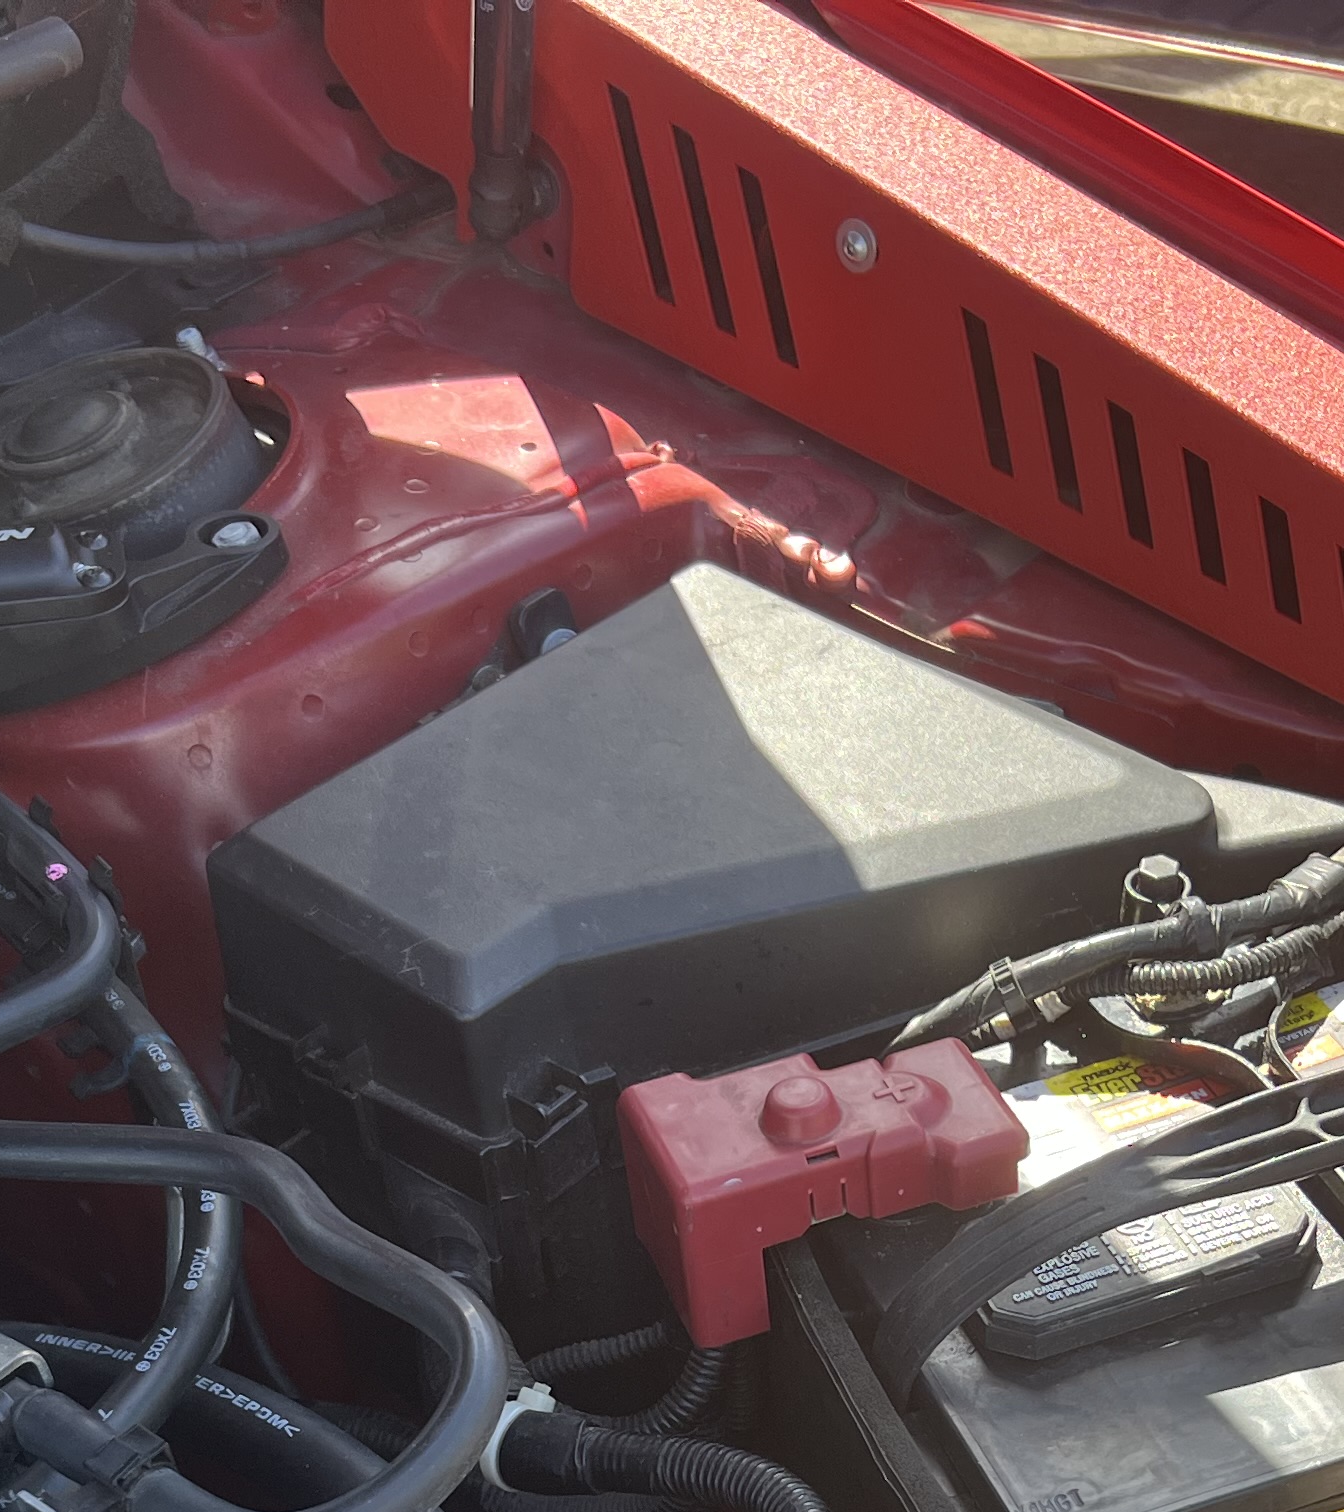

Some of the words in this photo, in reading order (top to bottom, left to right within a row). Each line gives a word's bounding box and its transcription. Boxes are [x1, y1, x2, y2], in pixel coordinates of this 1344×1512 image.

[1081, 1060, 1133, 1082] maxx
[1181, 1202, 1244, 1230] SULFURIC
[1244, 1192, 1276, 1212] ACID
[1130, 1231, 1156, 1246] NO
[187, 1246, 211, 1281] 7X03
[1032, 1245, 1100, 1275] EXPLOSIVE
[1037, 1263, 1081, 1284] GASES
[1012, 1289, 1035, 1304] CAN
[1033, 1279, 1068, 1297] CAUSE
[1065, 1263, 1120, 1287] BLINDNESS
[1046, 1289, 1065, 1303] OR
[1062, 1280, 1099, 1298] INJURY
[142, 1326, 178, 1362] 7X03
[195, 1375, 301, 1438] ER>EPDM<
